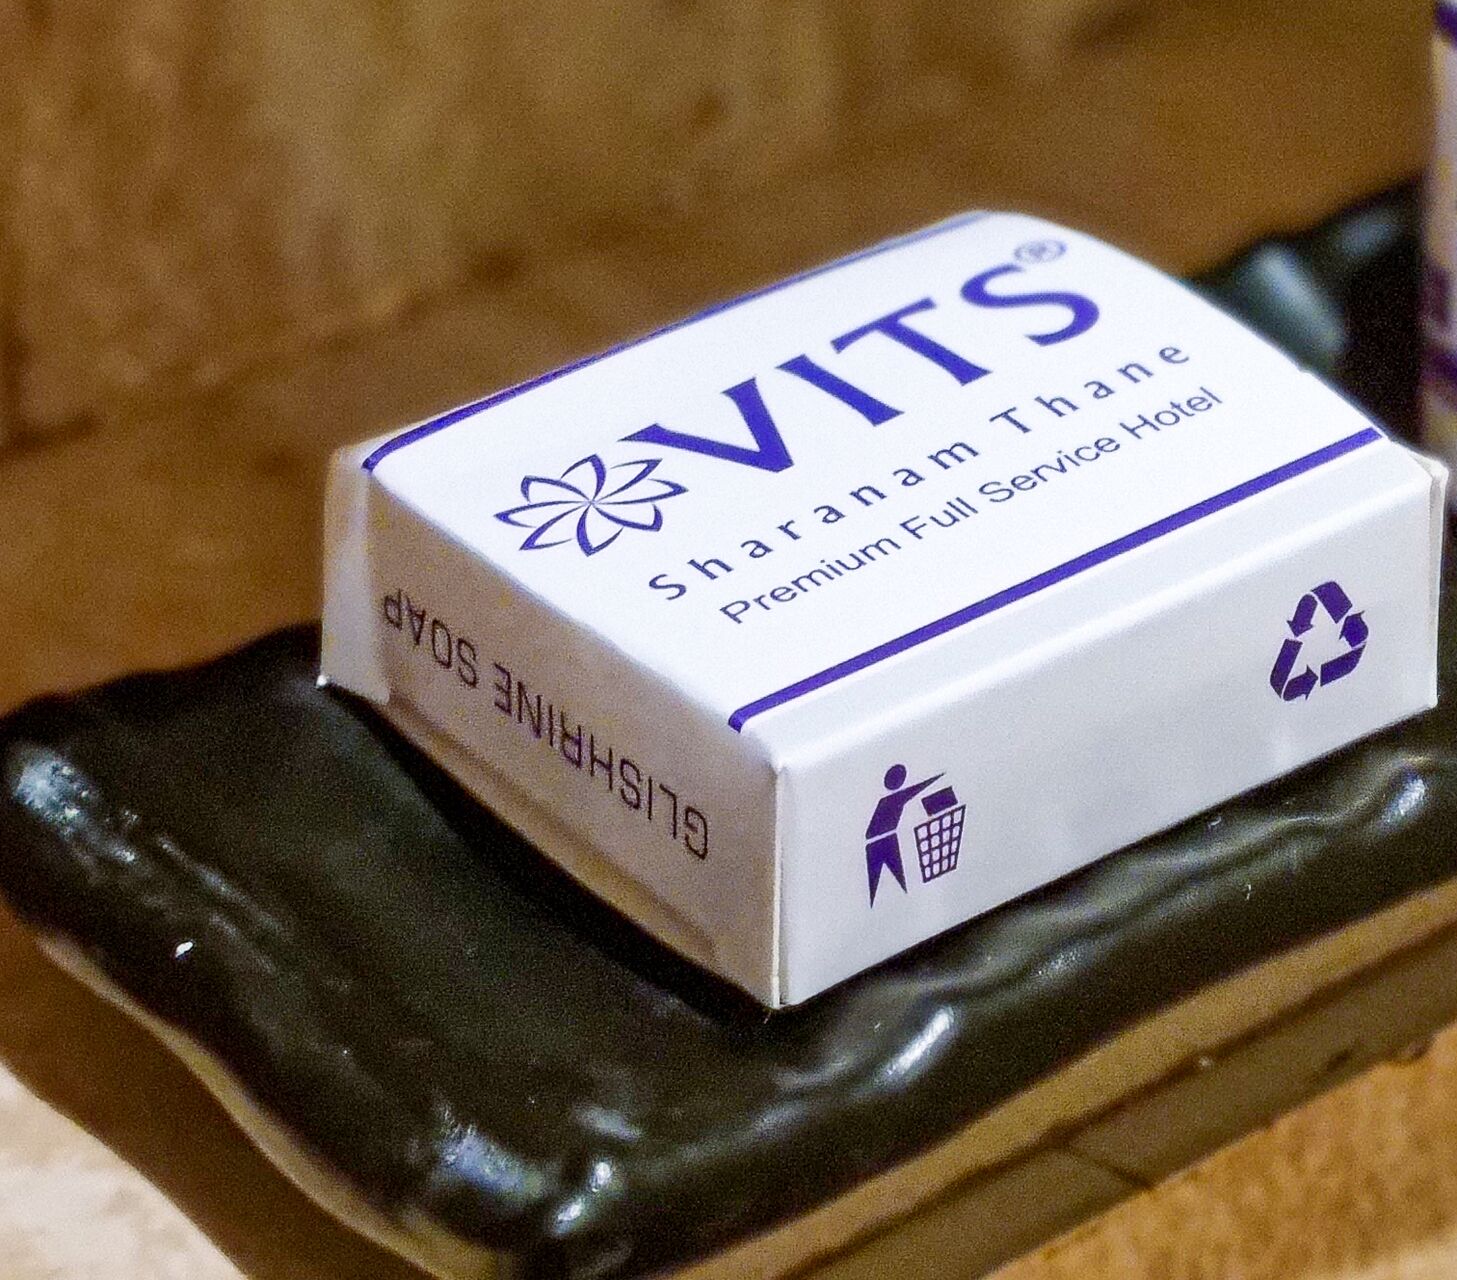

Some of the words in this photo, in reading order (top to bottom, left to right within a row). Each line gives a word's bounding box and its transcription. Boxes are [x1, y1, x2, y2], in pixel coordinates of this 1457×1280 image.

[617, 263, 1100, 475] VITS
[648, 439, 980, 602] Sharanam
[989, 344, 1190, 434] Thane
[719, 536, 902, 626] Premium
[905, 490, 978, 541] Full
[978, 436, 1121, 504] Service
[1119, 386, 1223, 440] Hotel
[383, 589, 479, 689] SOAP
[493, 661, 710, 861] GLISHRINE
